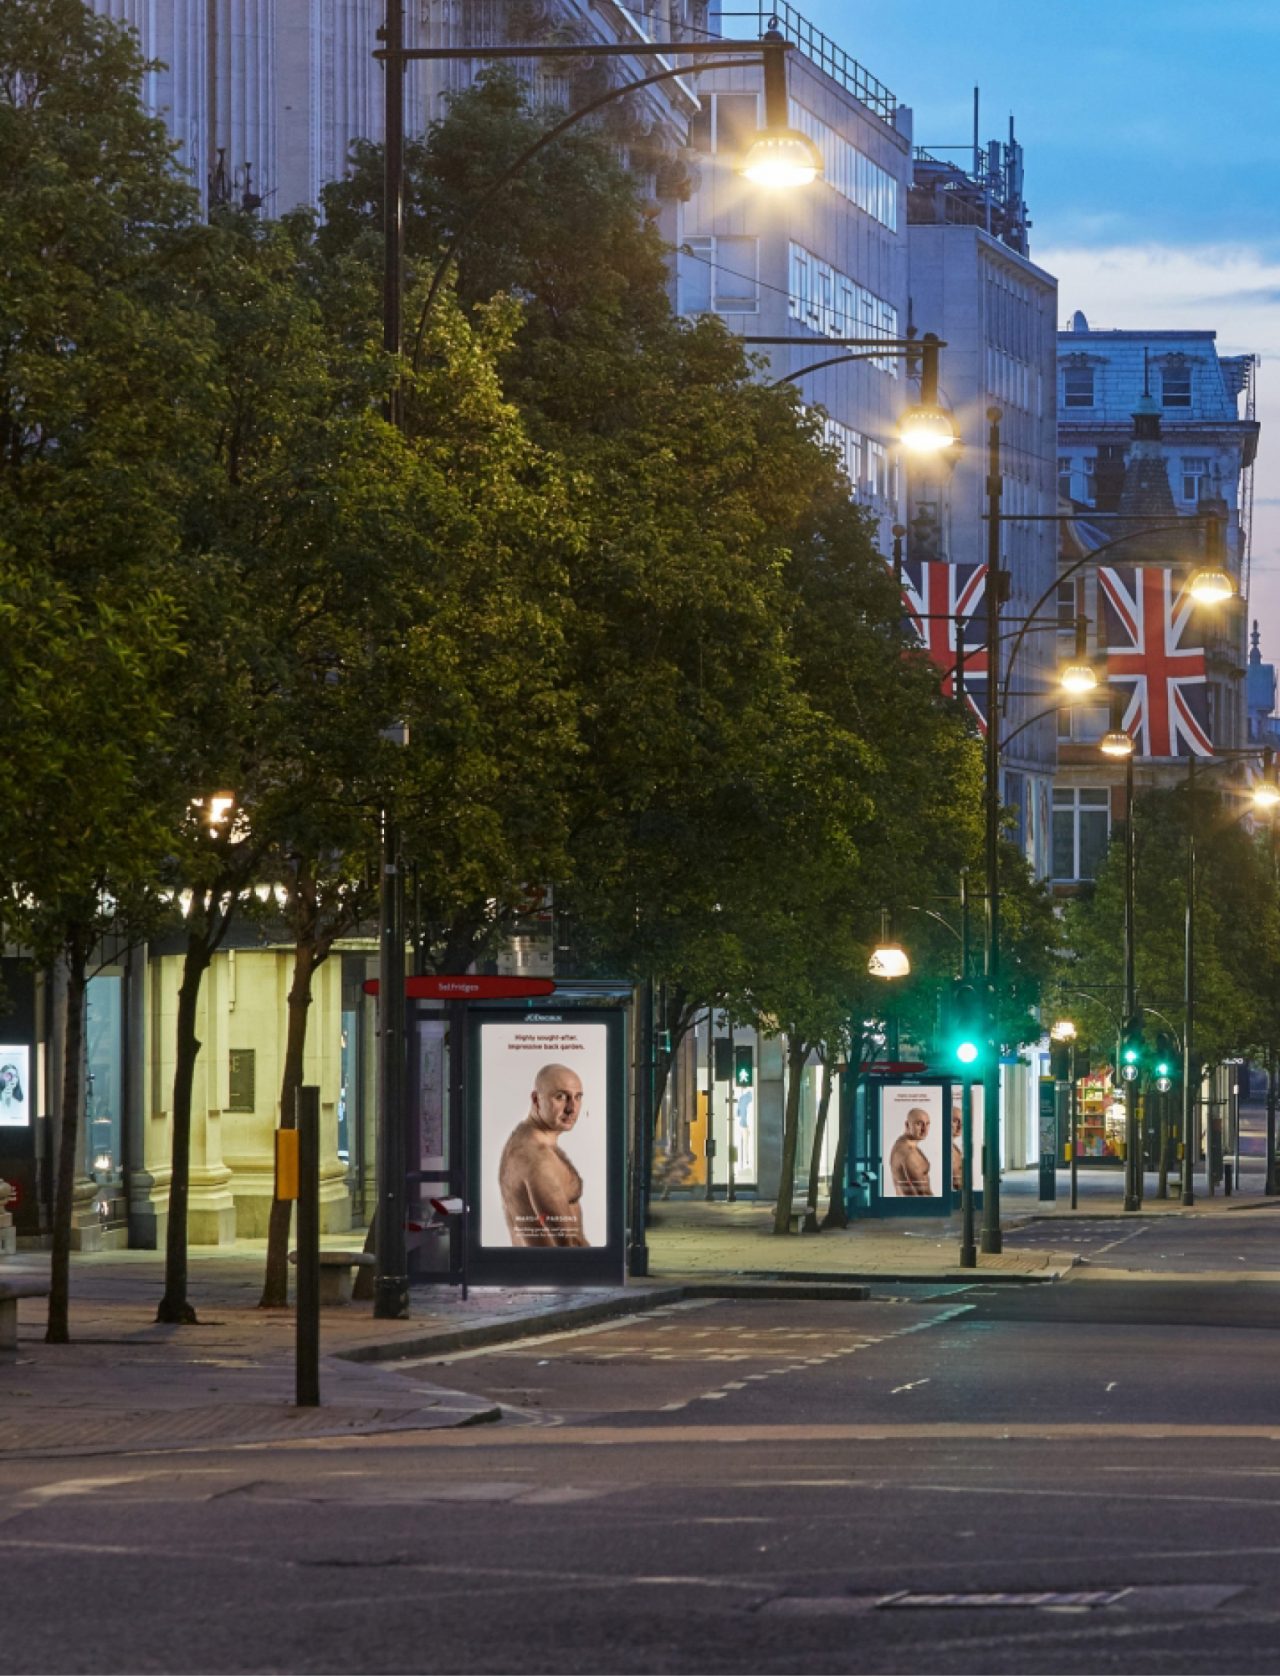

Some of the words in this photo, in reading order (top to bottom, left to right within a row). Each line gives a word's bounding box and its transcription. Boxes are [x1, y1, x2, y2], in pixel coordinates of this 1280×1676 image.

[438, 982, 479, 993] Selfridges
[514, 1034, 535, 1043] Highly
[508, 1043, 541, 1051] Impressive
